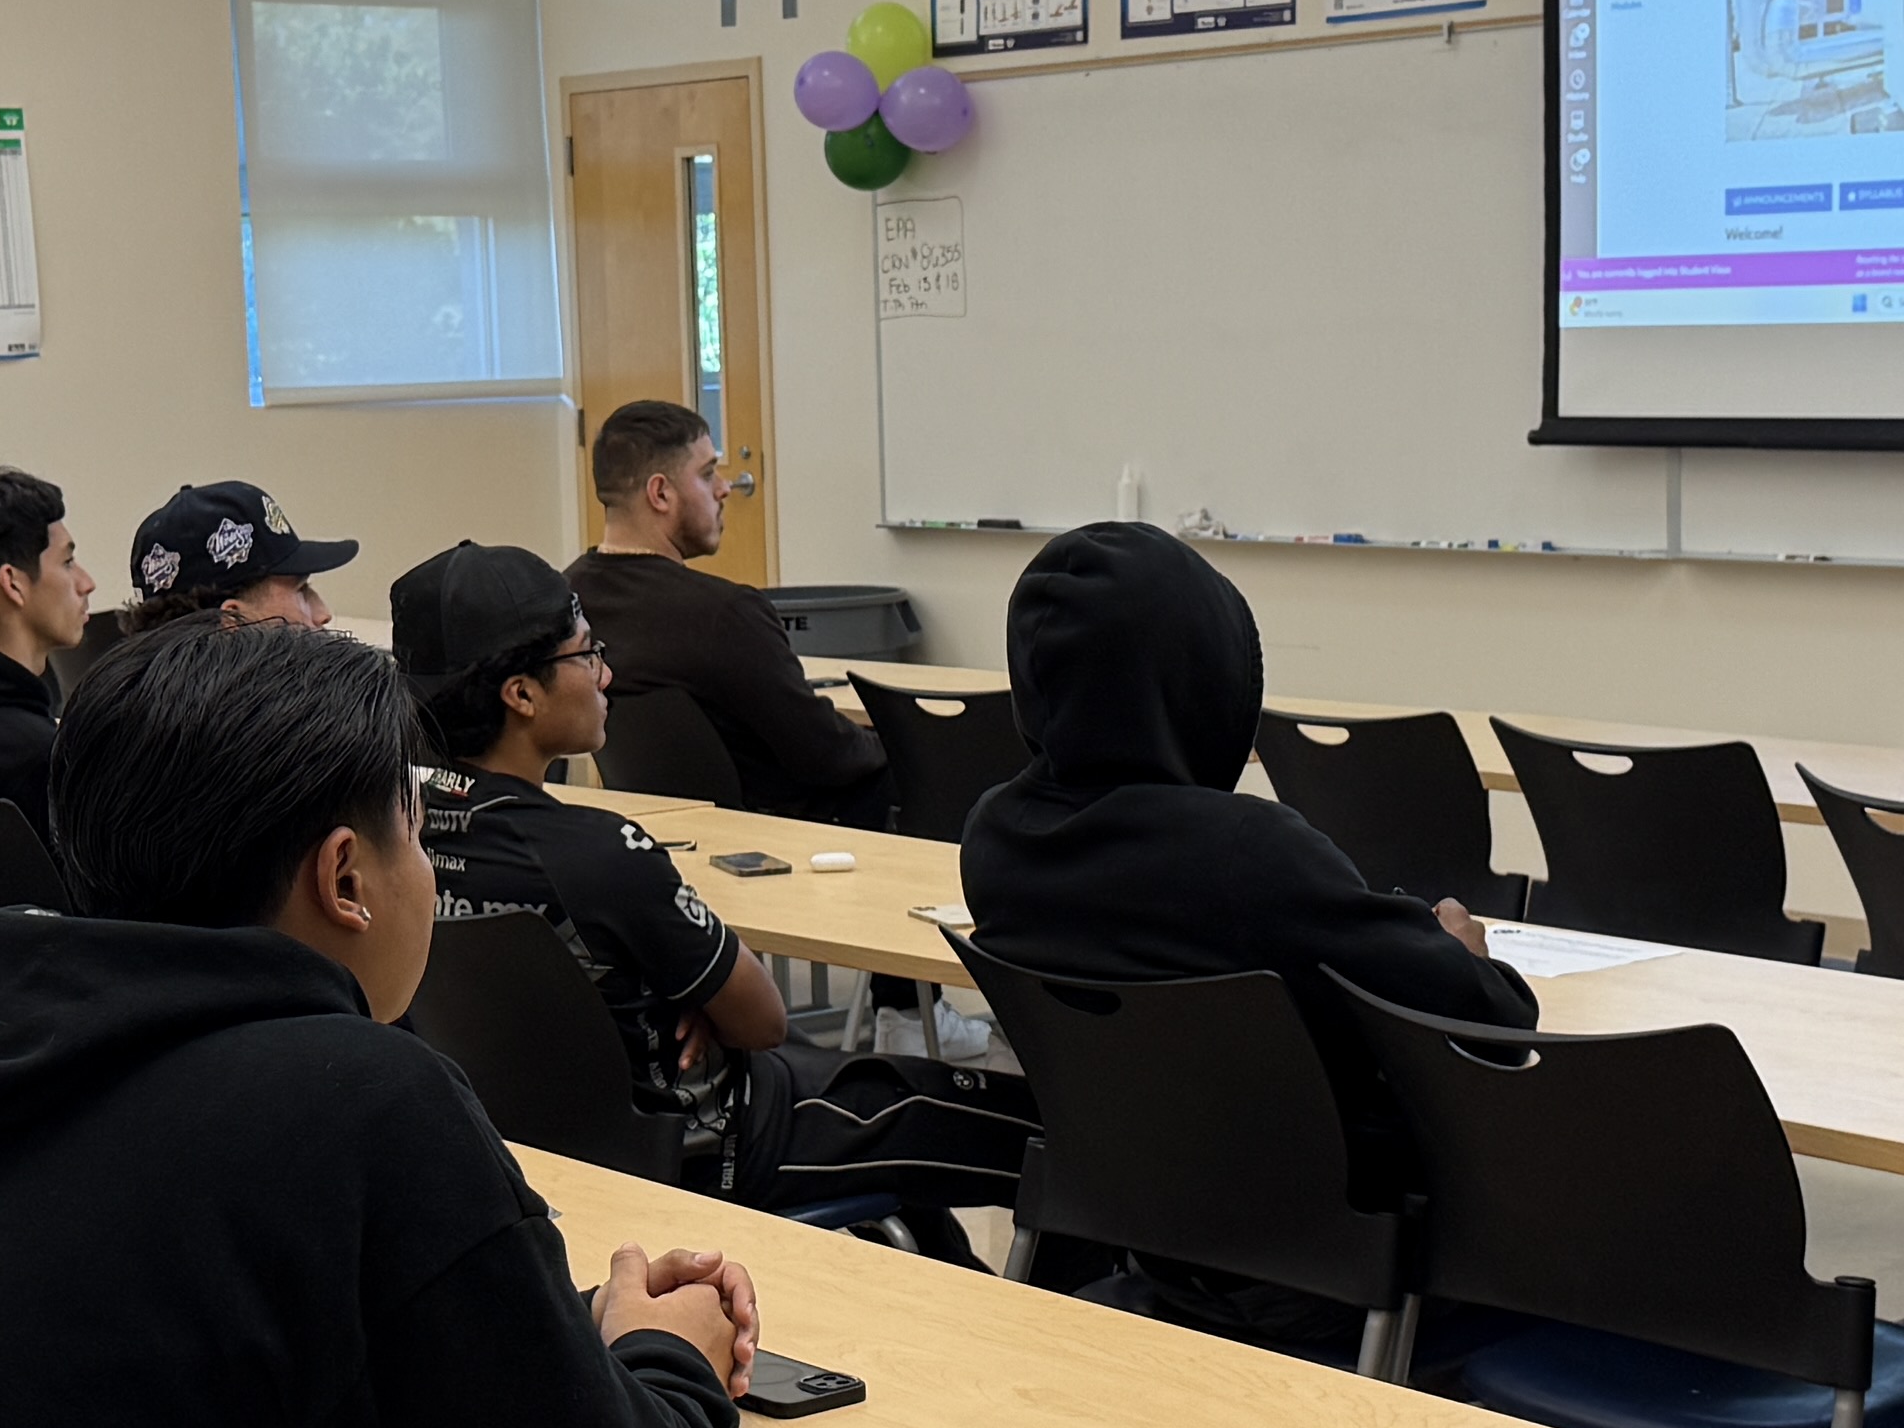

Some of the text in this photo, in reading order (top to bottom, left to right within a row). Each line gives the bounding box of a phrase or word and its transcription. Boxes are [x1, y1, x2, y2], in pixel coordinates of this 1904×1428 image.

[885, 217, 916, 242] EPA
[1725, 225, 1784, 241] Welcome!
[889, 277, 911, 295] Feb
